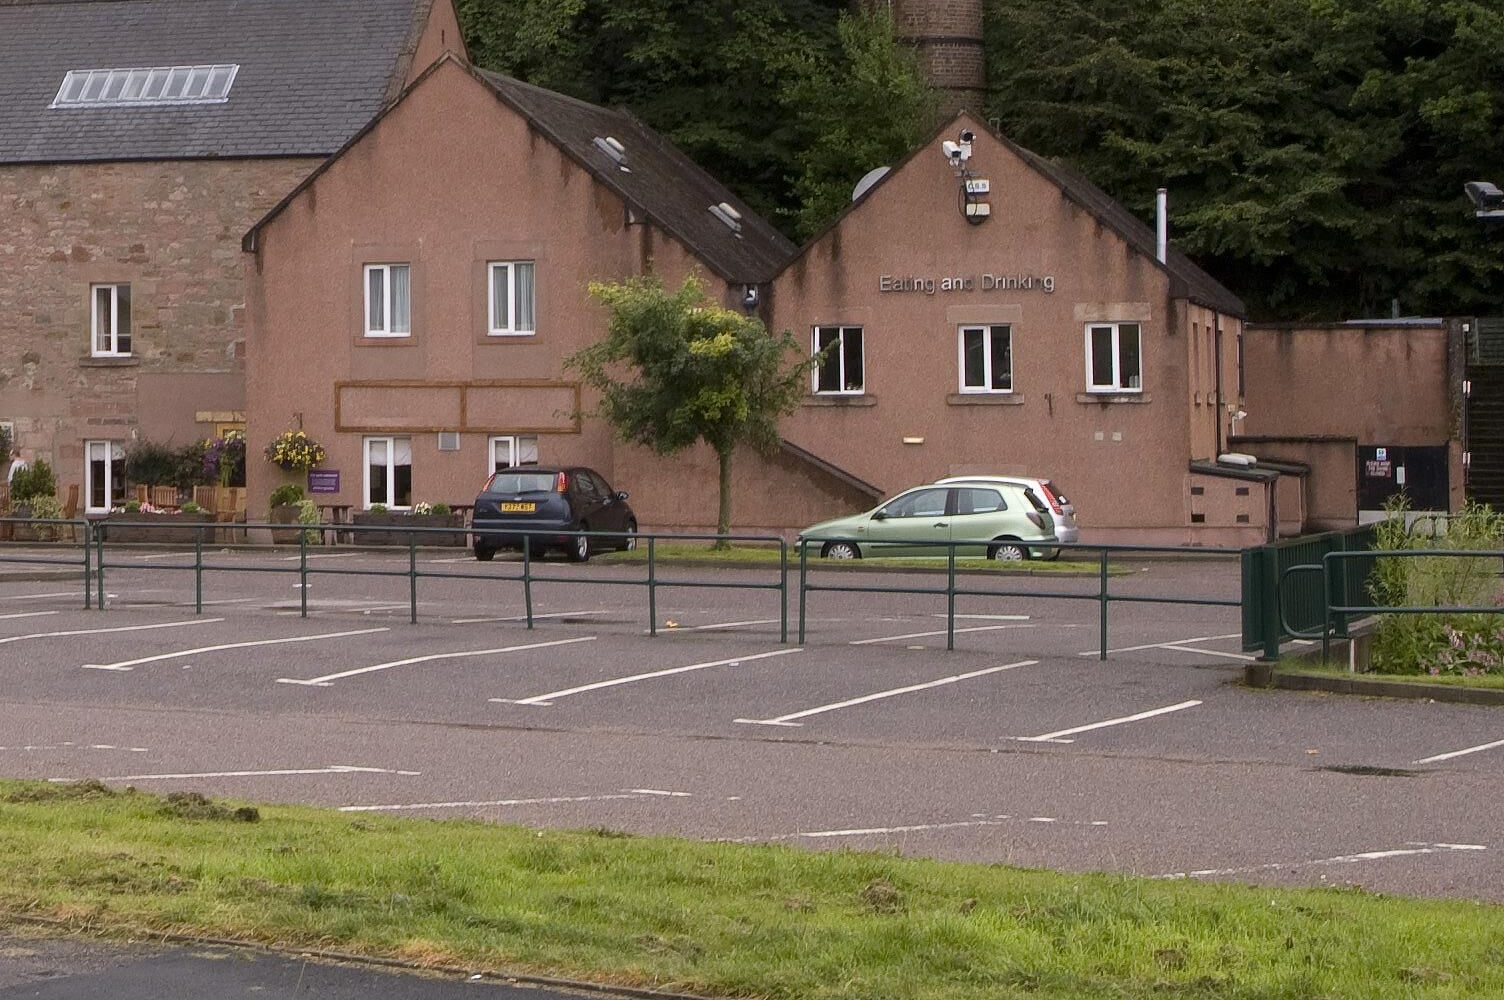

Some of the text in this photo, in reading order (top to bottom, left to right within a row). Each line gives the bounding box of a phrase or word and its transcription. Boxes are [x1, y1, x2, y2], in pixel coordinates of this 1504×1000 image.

[879, 273, 1055, 295] Eating and Drinking
